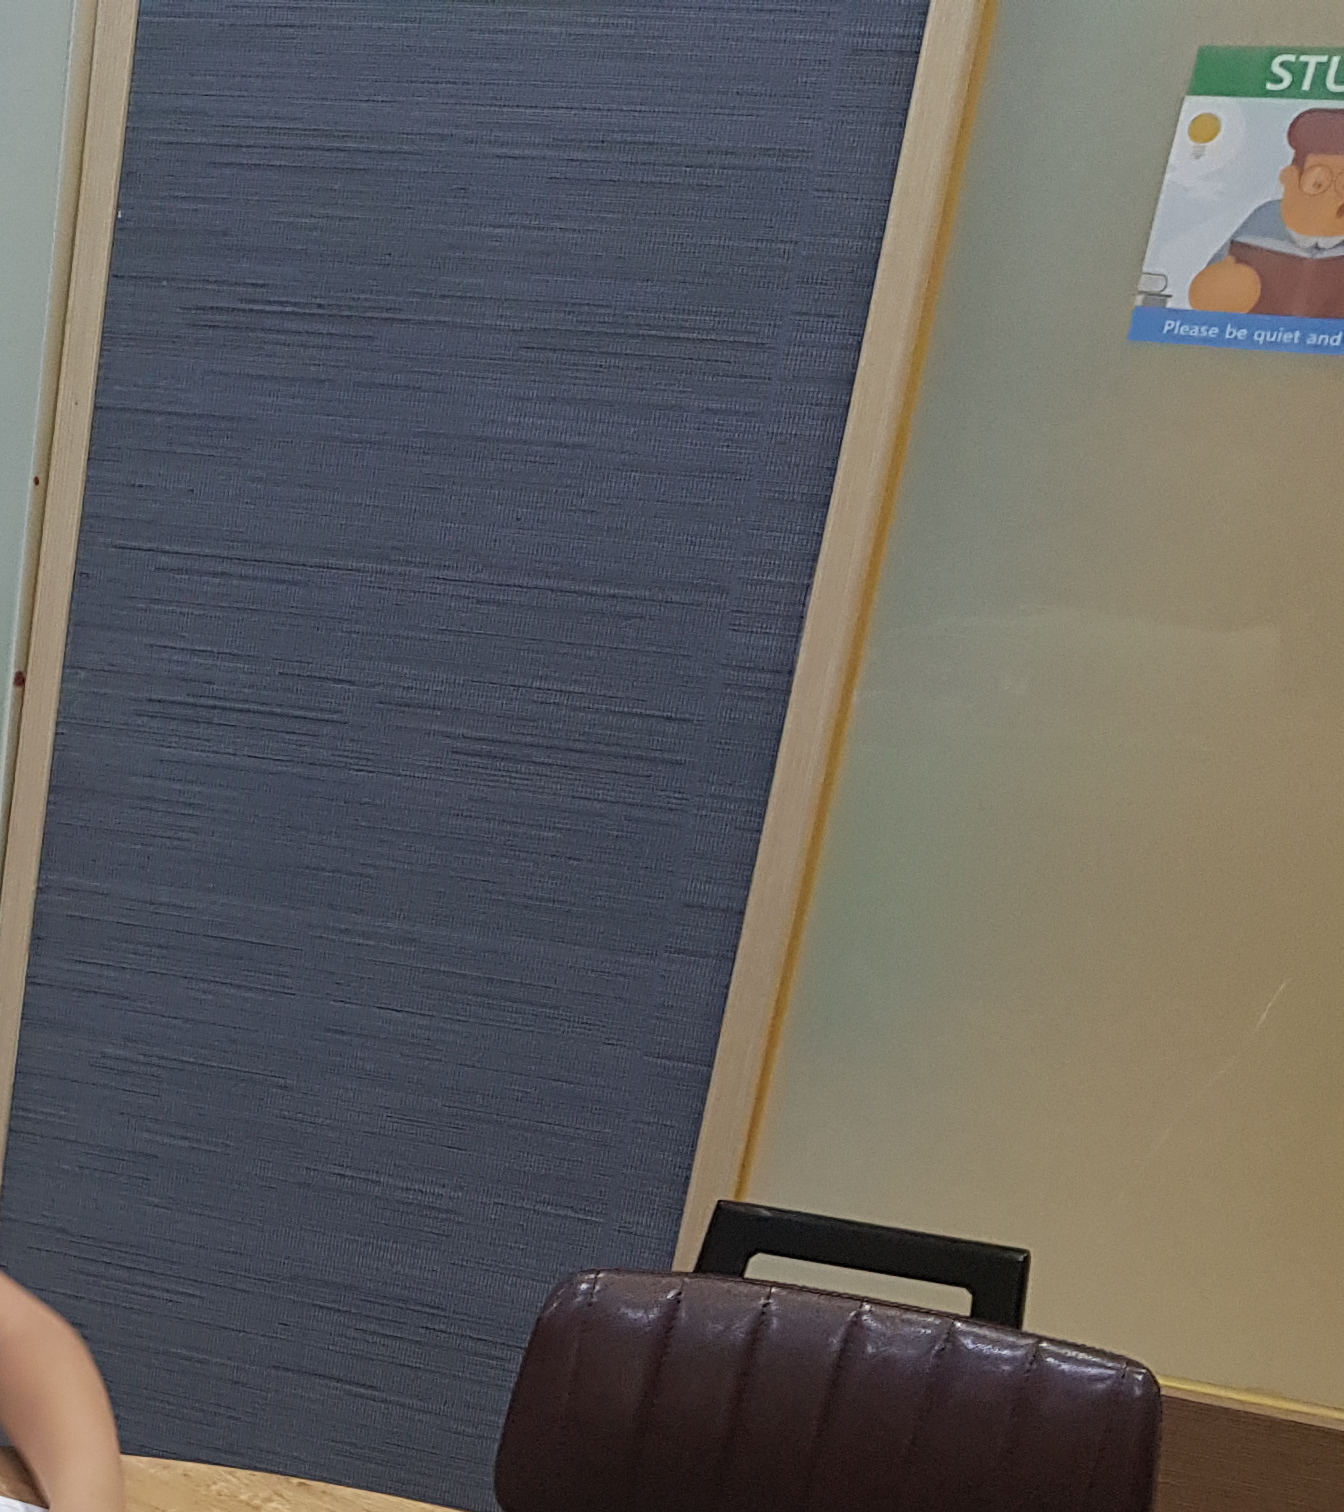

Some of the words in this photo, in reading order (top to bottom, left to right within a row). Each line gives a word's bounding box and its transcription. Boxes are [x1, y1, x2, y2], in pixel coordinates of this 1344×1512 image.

[1162, 319, 1220, 339] Please
[1224, 323, 1248, 341] be
[1253, 326, 1301, 346] quiet
[1306, 331, 1342, 347] and
